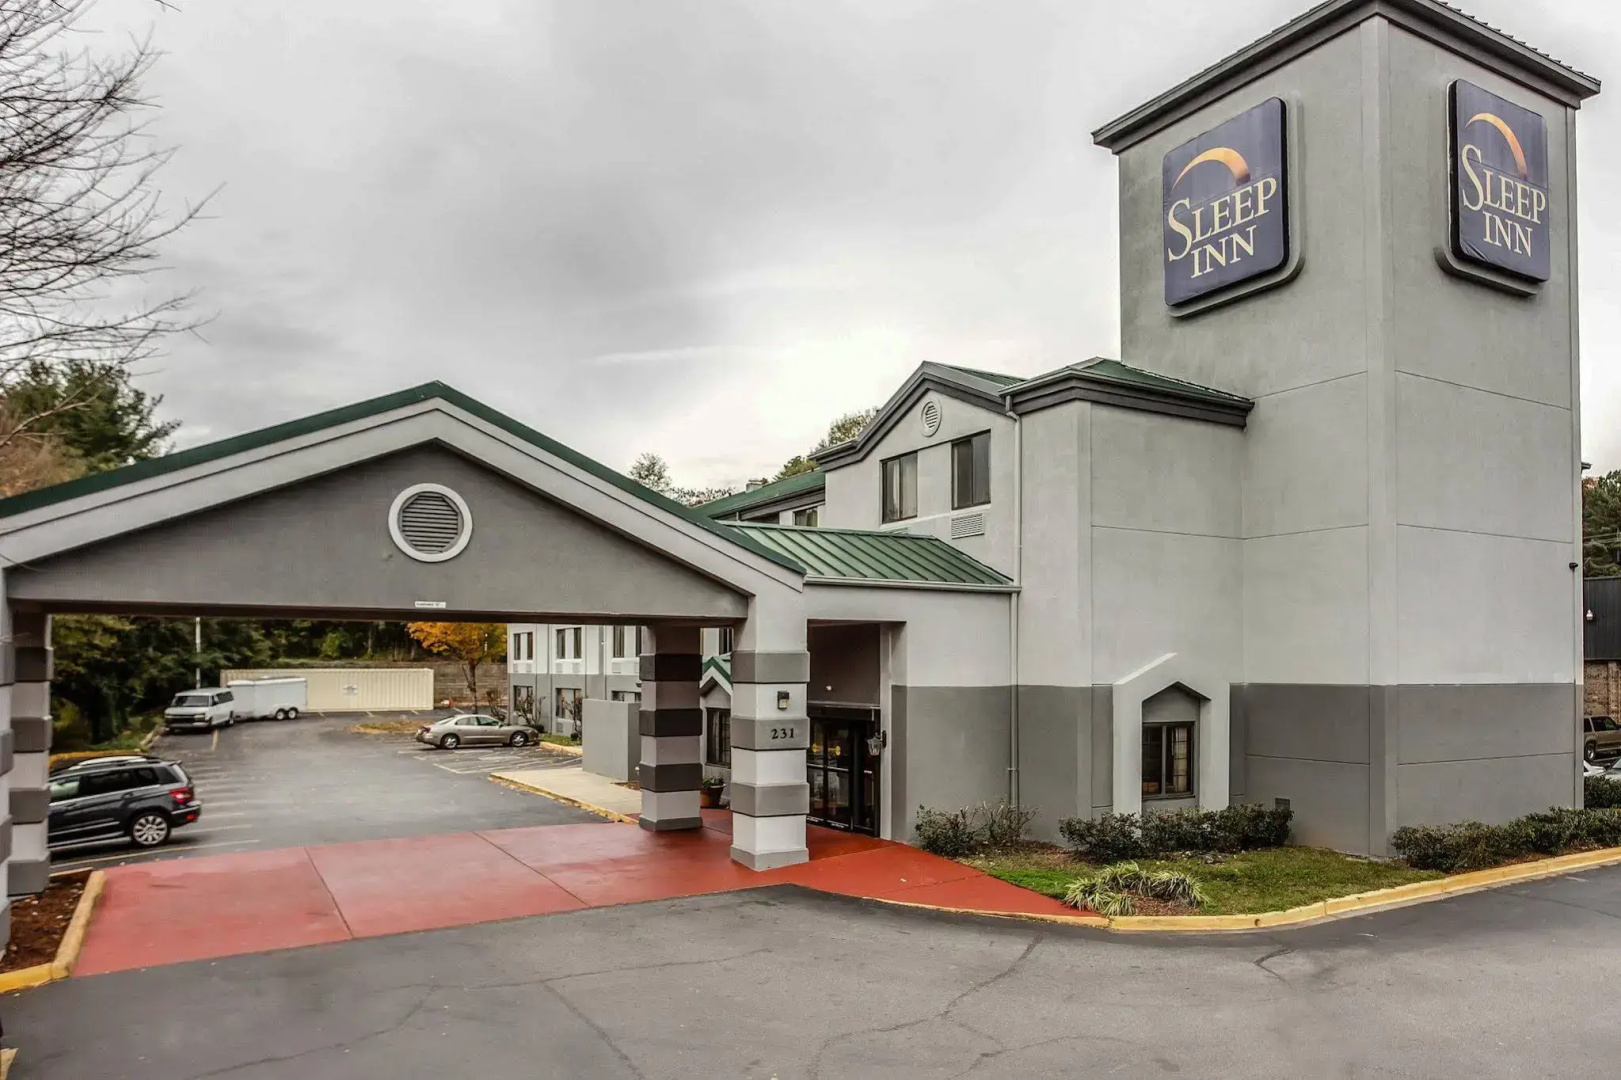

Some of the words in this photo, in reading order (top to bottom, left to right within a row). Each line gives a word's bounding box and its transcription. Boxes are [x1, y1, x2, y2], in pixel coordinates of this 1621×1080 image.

[1462, 144, 1546, 225] SLEEP
[1168, 177, 1277, 261] SLEEP
[1483, 211, 1533, 257] INN
[1191, 225, 1257, 278] INN
[771, 728, 795, 739] 231
